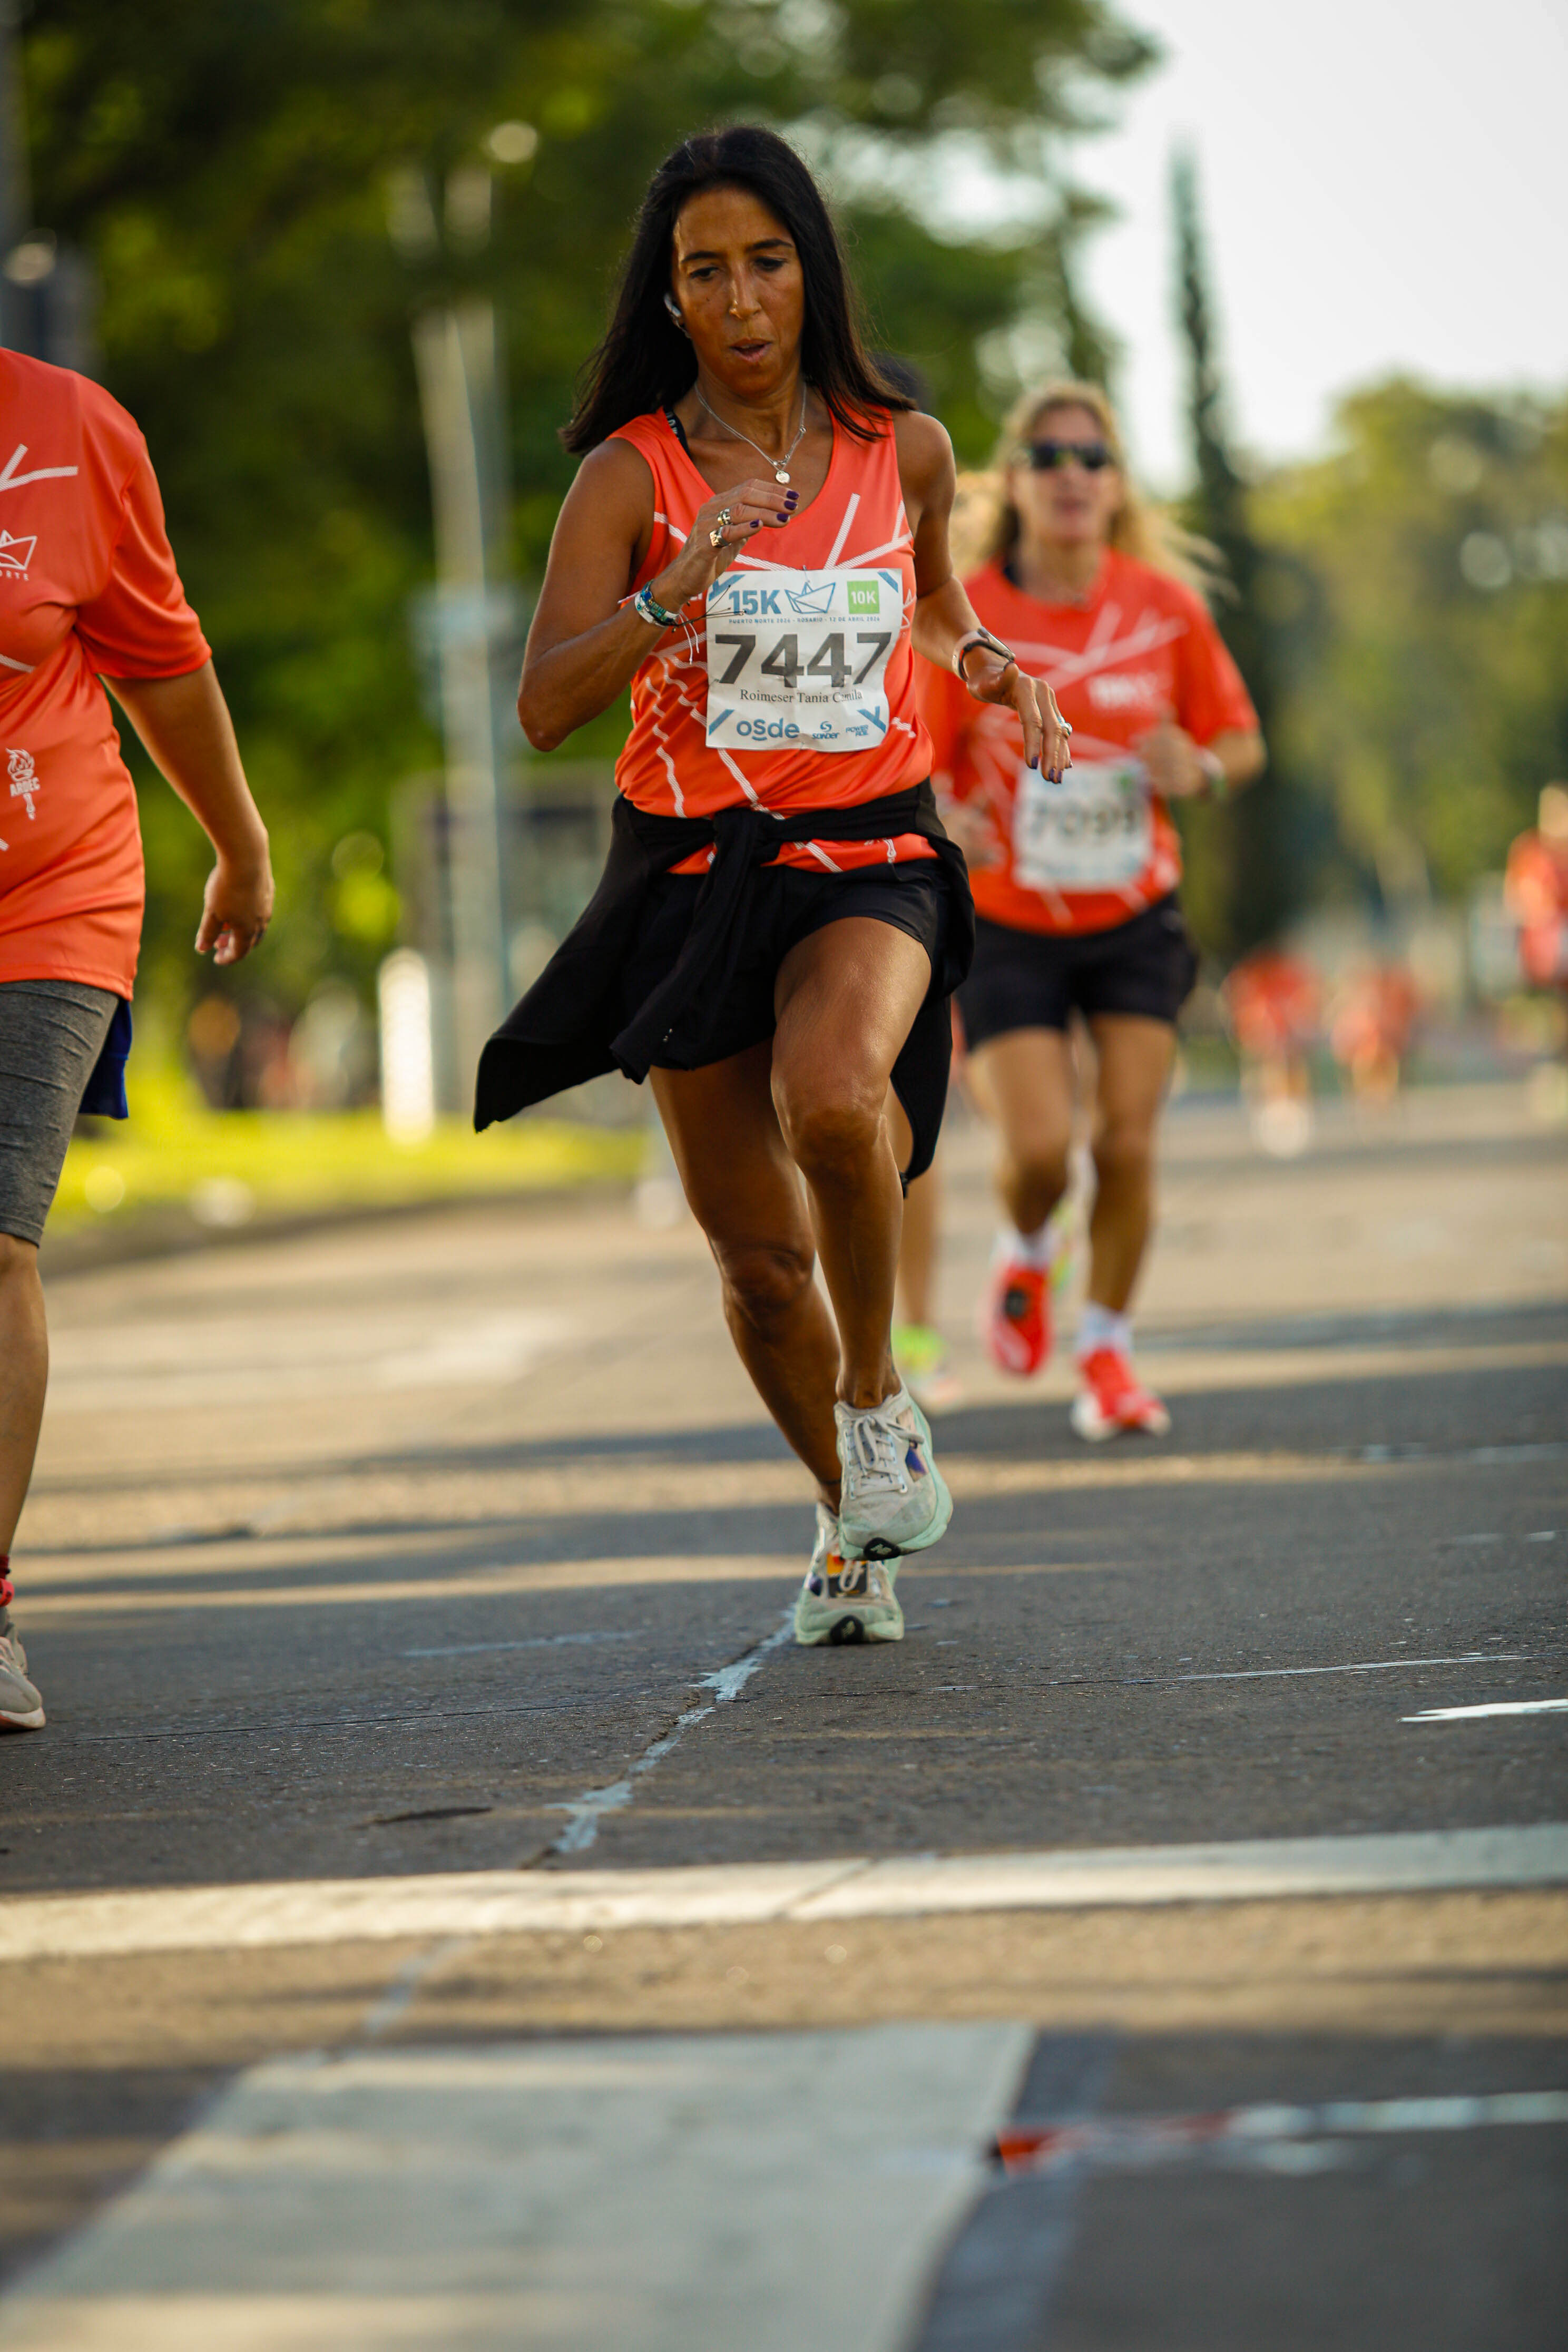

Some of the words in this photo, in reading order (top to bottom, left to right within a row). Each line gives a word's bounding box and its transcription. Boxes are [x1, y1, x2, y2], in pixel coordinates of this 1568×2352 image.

[729, 590, 781, 615] 15K
[851, 591, 877, 604] 10K
[715, 632, 892, 688] 7447
[740, 689, 794, 703] Roimeser
[797, 692, 829, 703] Tania
[736, 717, 800, 741] osde
